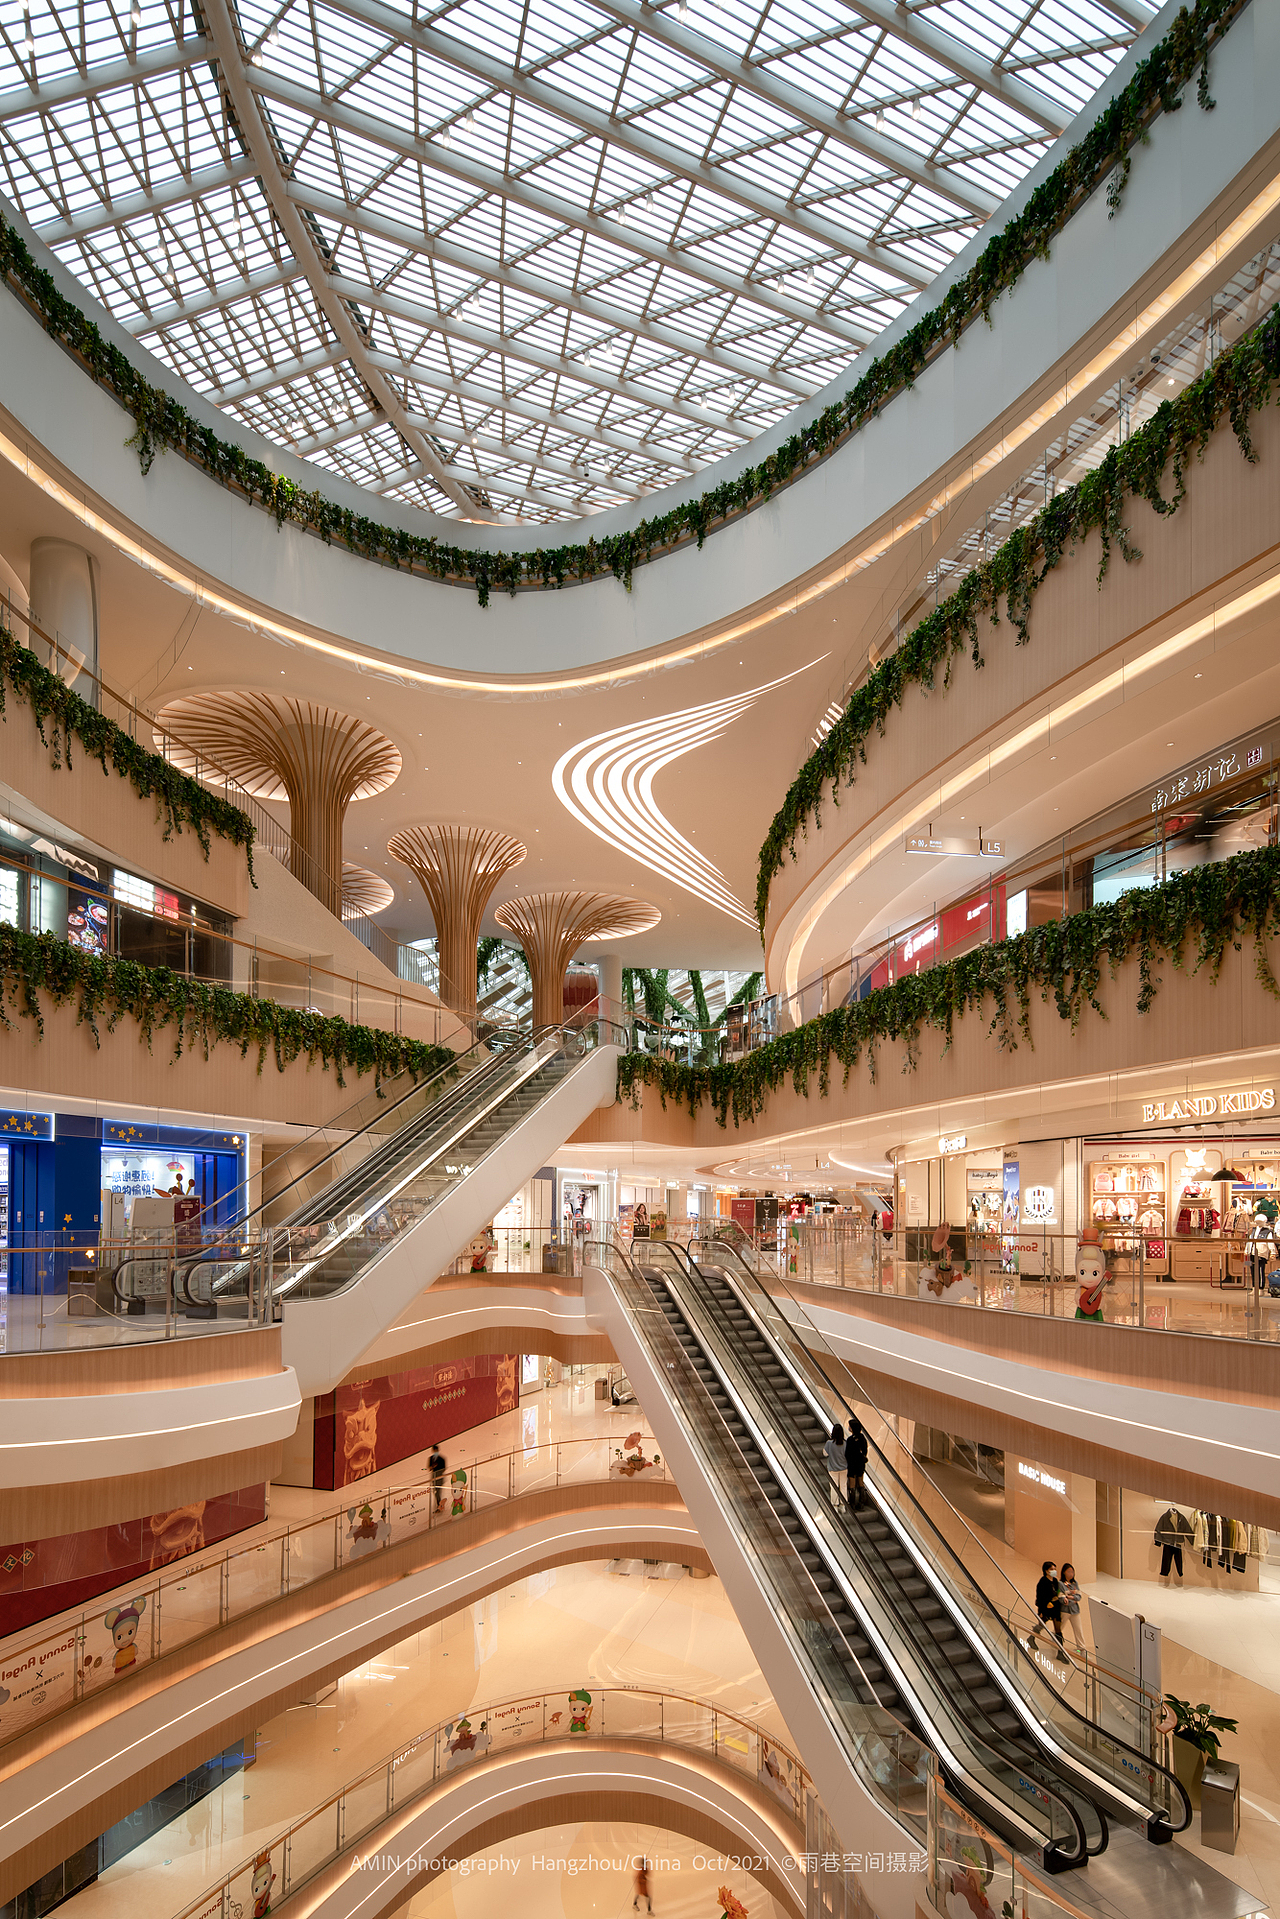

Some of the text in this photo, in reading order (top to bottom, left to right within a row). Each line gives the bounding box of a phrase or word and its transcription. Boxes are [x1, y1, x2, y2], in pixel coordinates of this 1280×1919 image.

[987, 842, 1001, 853] L5
[1219, 1088, 1276, 1114] KIDS
[820, 1161, 830, 1169] L4
[114, 1197, 124, 1205] L4
[1018, 1461, 1066, 1495] BASIC HOUSE
[1144, 1628, 1155, 1642] L3
